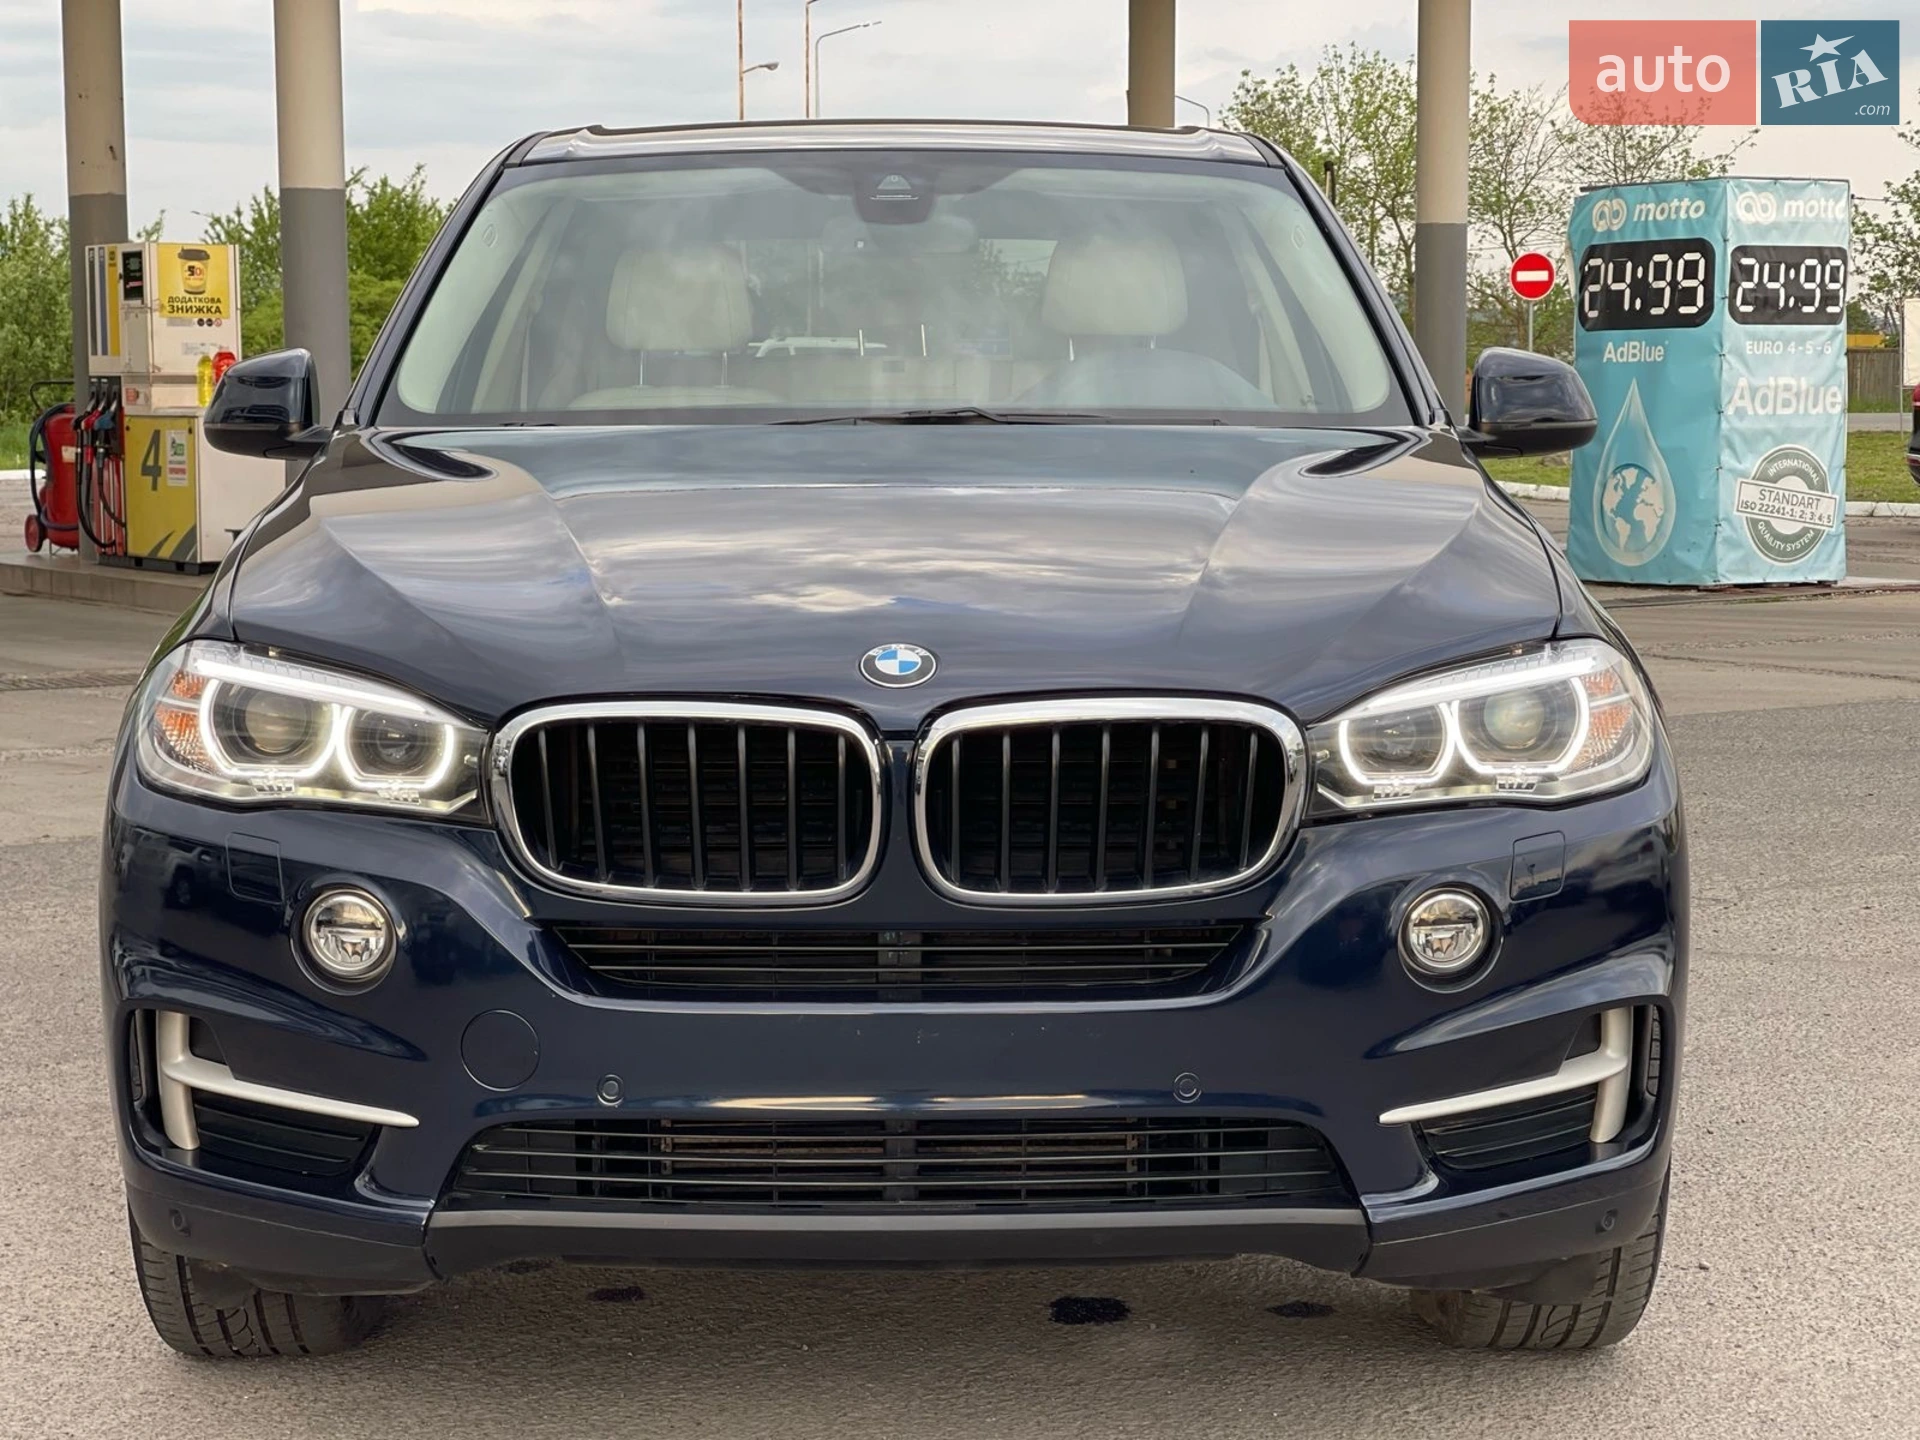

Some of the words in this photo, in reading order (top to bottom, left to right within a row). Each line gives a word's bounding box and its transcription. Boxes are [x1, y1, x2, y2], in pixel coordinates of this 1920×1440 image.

[1633, 197, 1706, 222] motto
[168, 296, 222, 304] ДОДАТКОВА
[168, 304, 222, 315] ЗНИЖКА
[1603, 341, 1665, 363] AdBlue
[1746, 340, 1784, 355] EURO
[1727, 376, 1843, 416] AdBlue
[141, 429, 162, 491] 4
[1767, 458, 1820, 485] INTERNATIONAL
[1740, 500, 1757, 511] ISO
[1759, 488, 1821, 511] STANDART
[1786, 529, 1815, 551] SYSTEM
